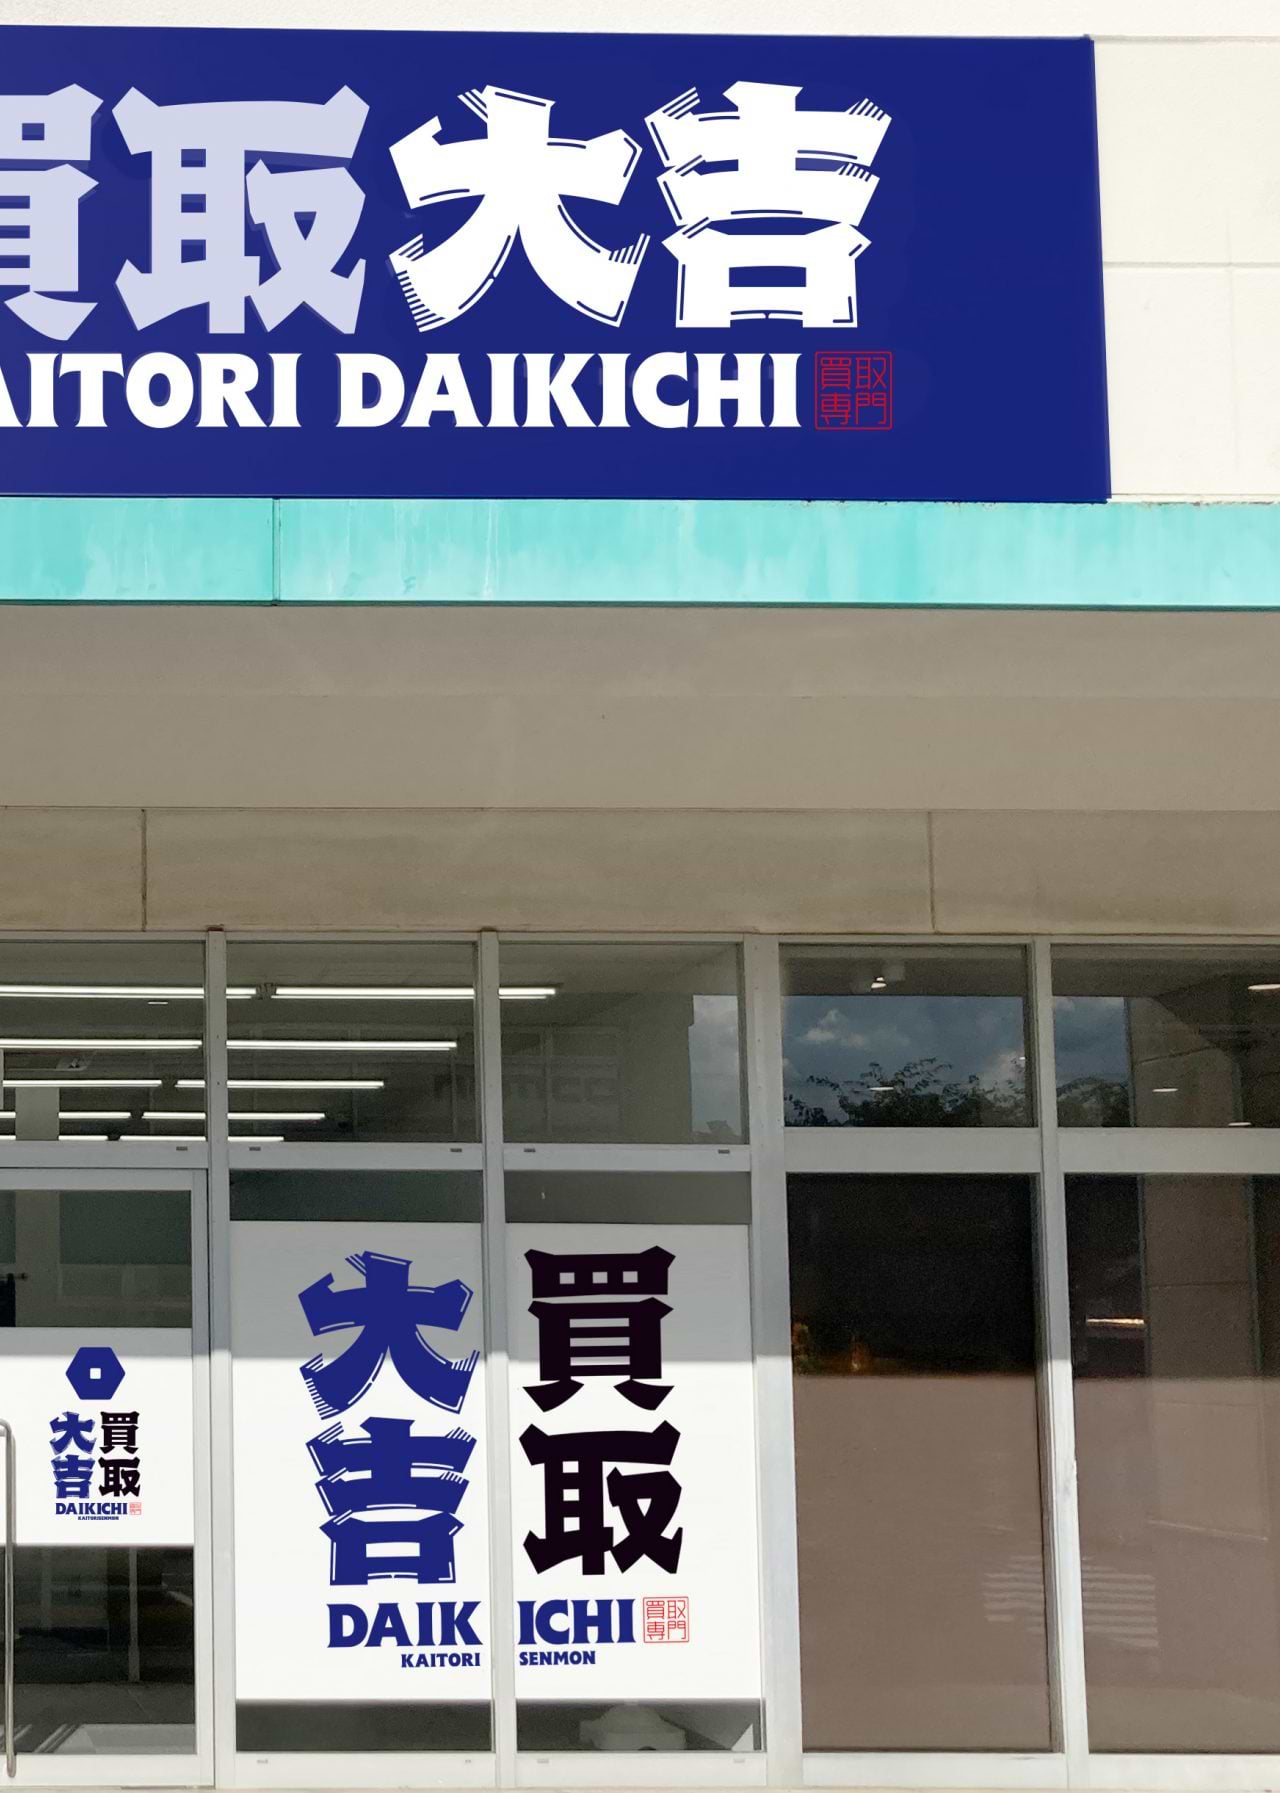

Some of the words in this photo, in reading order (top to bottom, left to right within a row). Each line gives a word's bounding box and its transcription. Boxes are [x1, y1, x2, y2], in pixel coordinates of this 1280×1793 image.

[821, 357, 887, 389] 買取
[335, 351, 801, 429] DAIKICHI
[821, 392, 887, 425] 専門
[298, 1250, 480, 1586] 大吉
[518, 1245, 683, 1576] 買取
[49, 1411, 97, 1499] 大吉
[98, 1411, 141, 1497] 買取
[55, 1502, 128, 1515] DAIKICHI
[646, 1600, 686, 1619] 買取
[646, 1620, 686, 1640] 専門
[401, 1652, 481, 1668] KAITORI
[519, 1650, 596, 1666] SENMON
